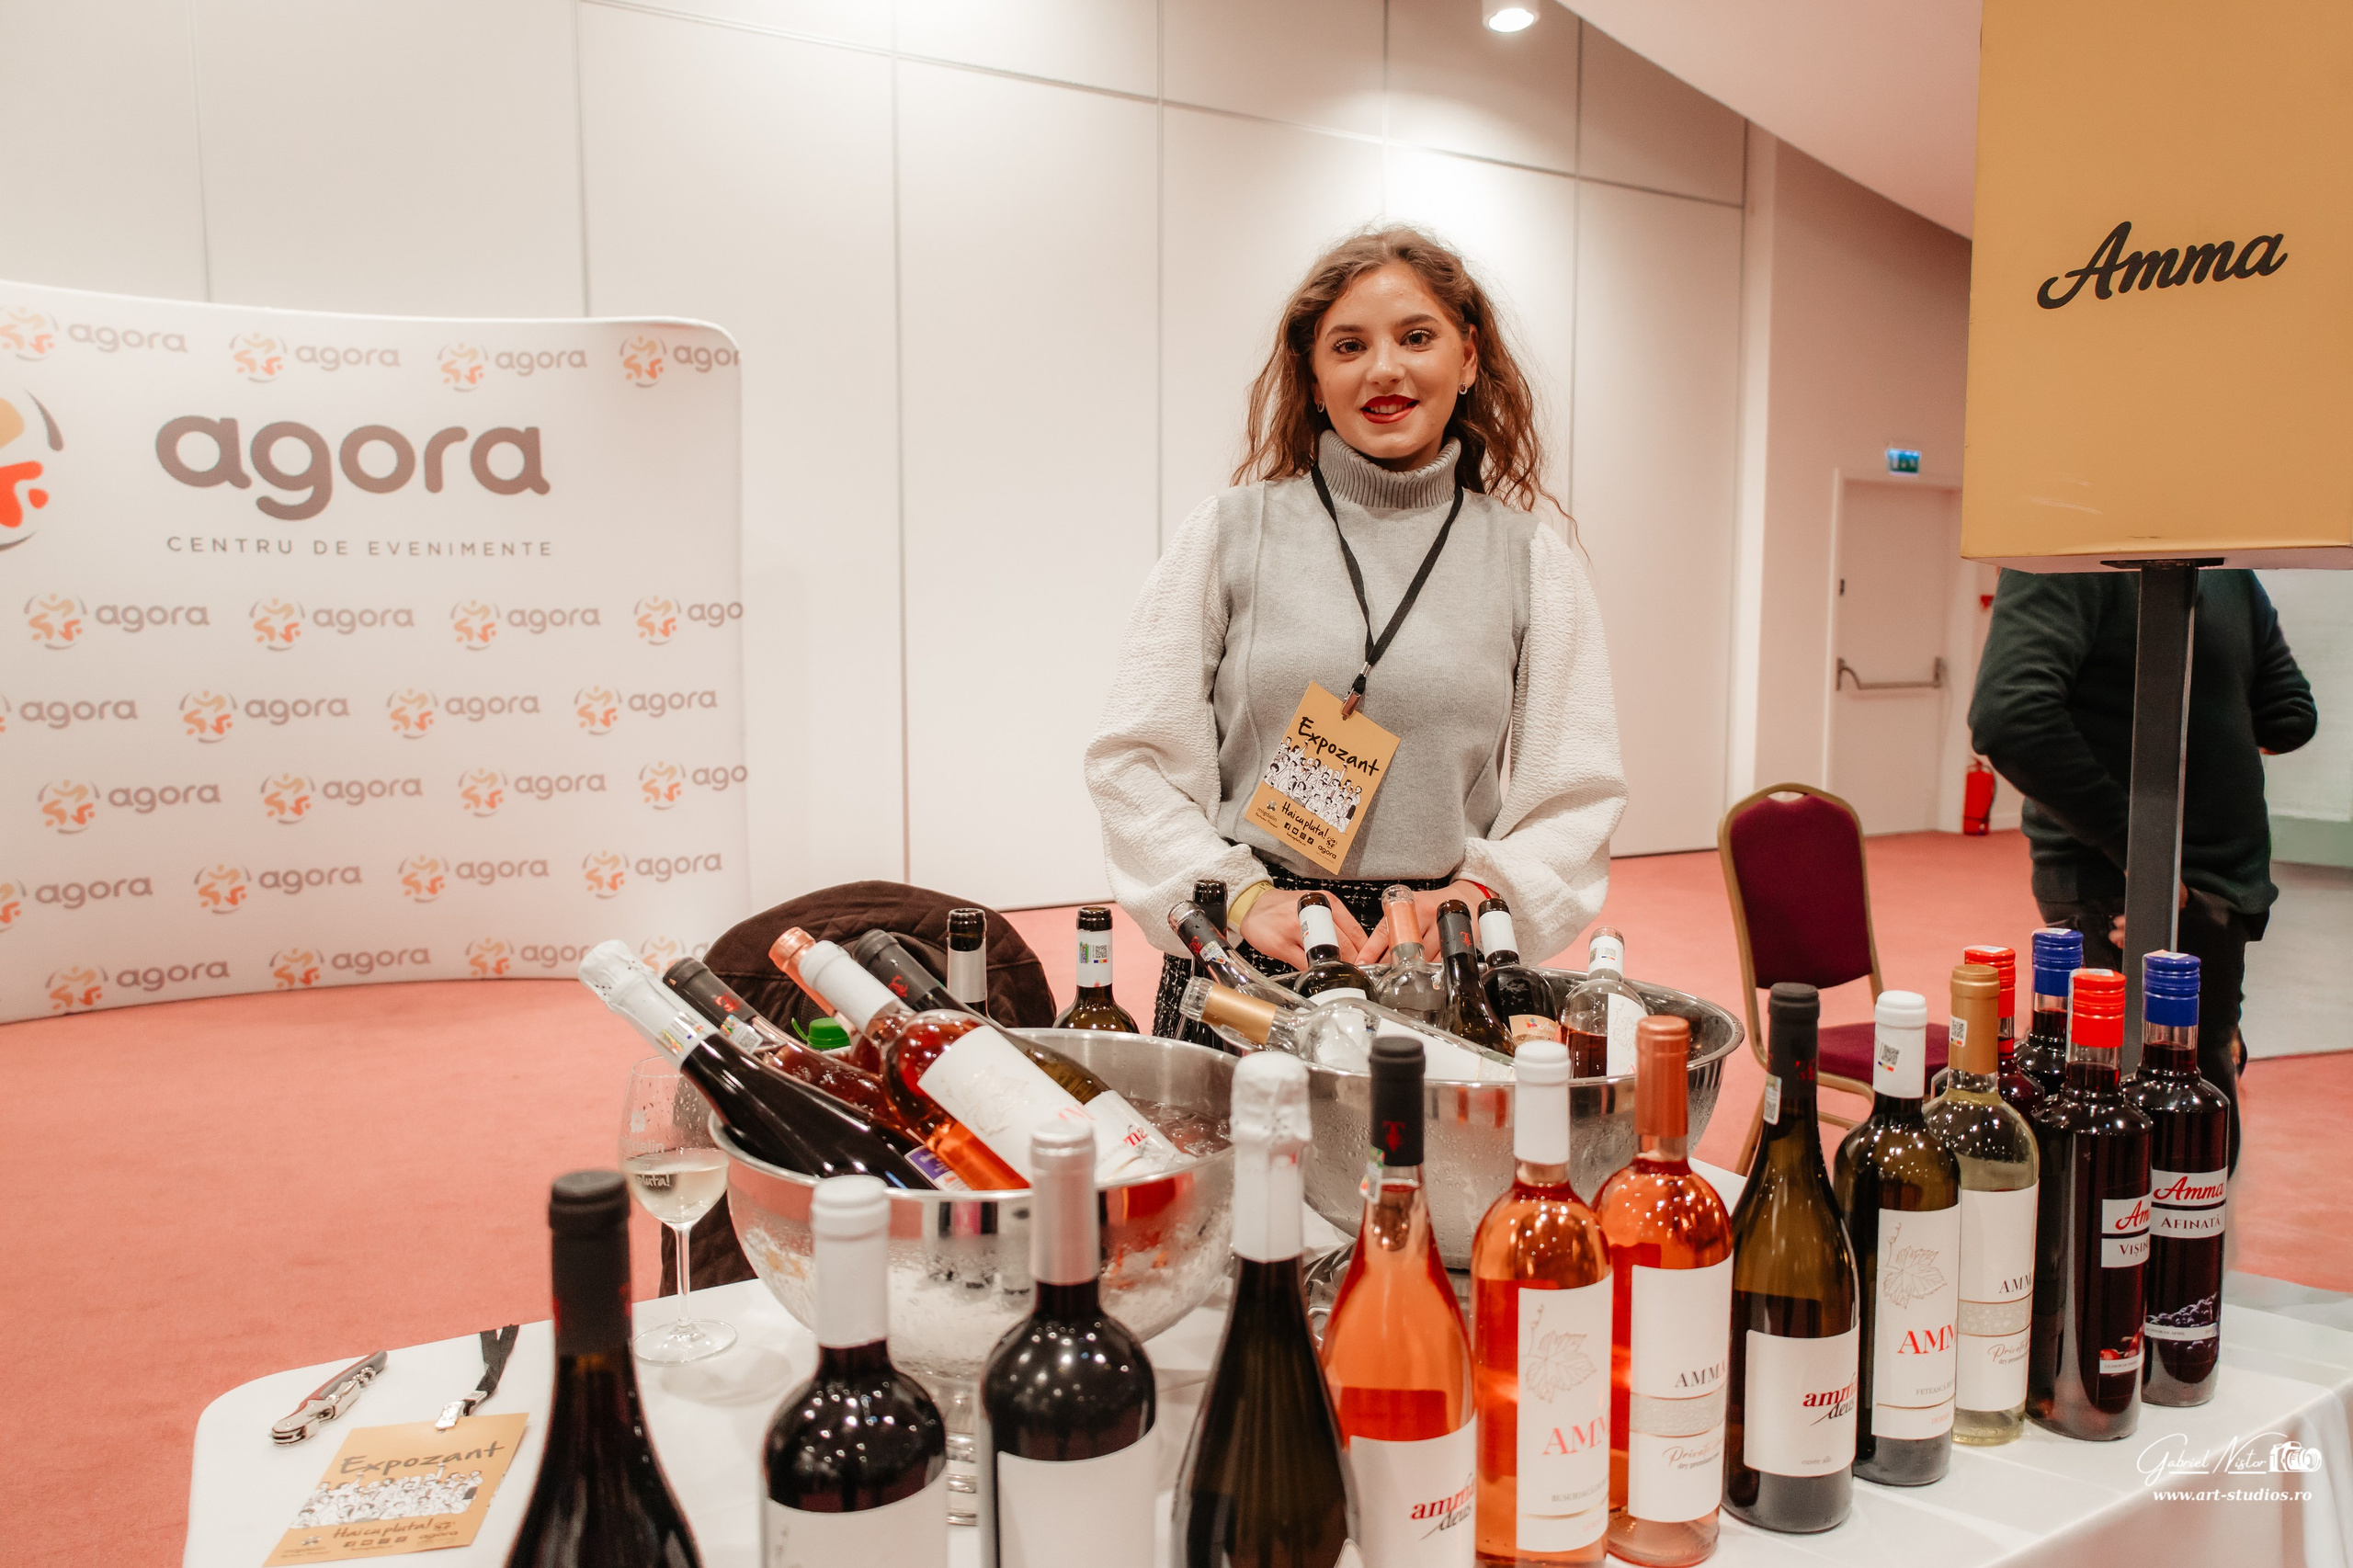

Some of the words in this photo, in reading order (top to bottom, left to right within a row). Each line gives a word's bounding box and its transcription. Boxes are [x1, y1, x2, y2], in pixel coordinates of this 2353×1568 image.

[2036, 221, 2289, 310] Amma
[67, 323, 189, 354] agora
[294, 344, 402, 373] agora
[495, 348, 589, 378] agora
[153, 415, 551, 522] agora
[167, 536, 293, 556] CENTRU
[313, 540, 349, 556] DE
[368, 540, 552, 558] EVENIMENTE
[95, 603, 210, 634] agora
[312, 607, 415, 636] agora
[506, 607, 601, 636] agora
[19, 699, 140, 731] agora
[244, 697, 351, 727] agora
[444, 694, 540, 723] agora
[627, 689, 719, 719] agora
[1297, 716, 1380, 777] Expozant
[108, 783, 222, 815] agora
[321, 777, 424, 807] agora
[513, 772, 608, 801] agora
[633, 851, 723, 883] agora
[1317, 845, 1337, 859] agora
[258, 865, 363, 896] agora
[455, 858, 551, 887] agora
[34, 876, 154, 911] agora
[116, 960, 231, 994] agora
[330, 947, 432, 977] agora
[2153, 1176, 2224, 1201] Amma
[2160, 1213, 2222, 1230] AFINATĂ
[339, 1440, 505, 1476] Expozant
